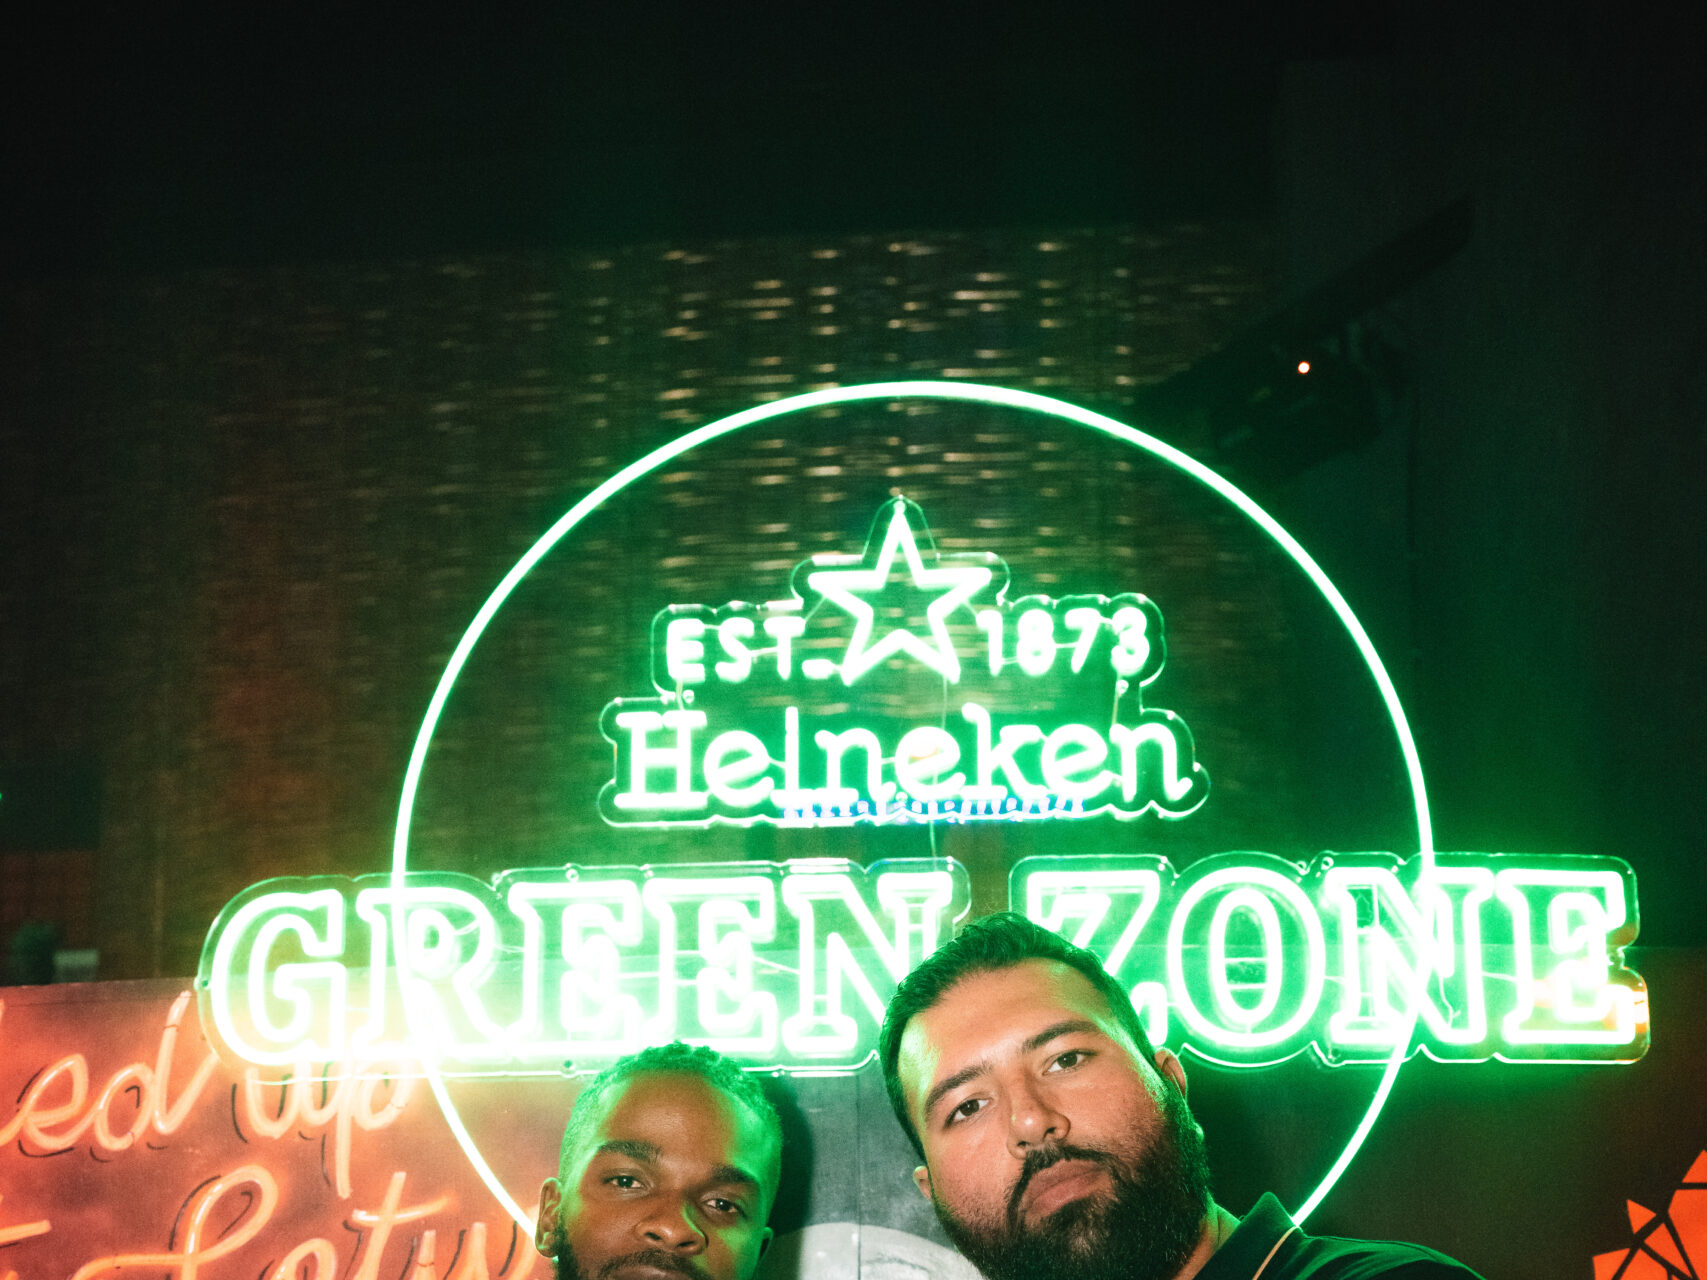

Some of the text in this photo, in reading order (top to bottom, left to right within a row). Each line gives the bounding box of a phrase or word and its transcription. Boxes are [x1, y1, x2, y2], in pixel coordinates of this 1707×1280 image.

[975, 606, 1150, 676] 1873
[613, 703, 1193, 808] Heineken
[210, 865, 1637, 1066] GREEN ZONE
